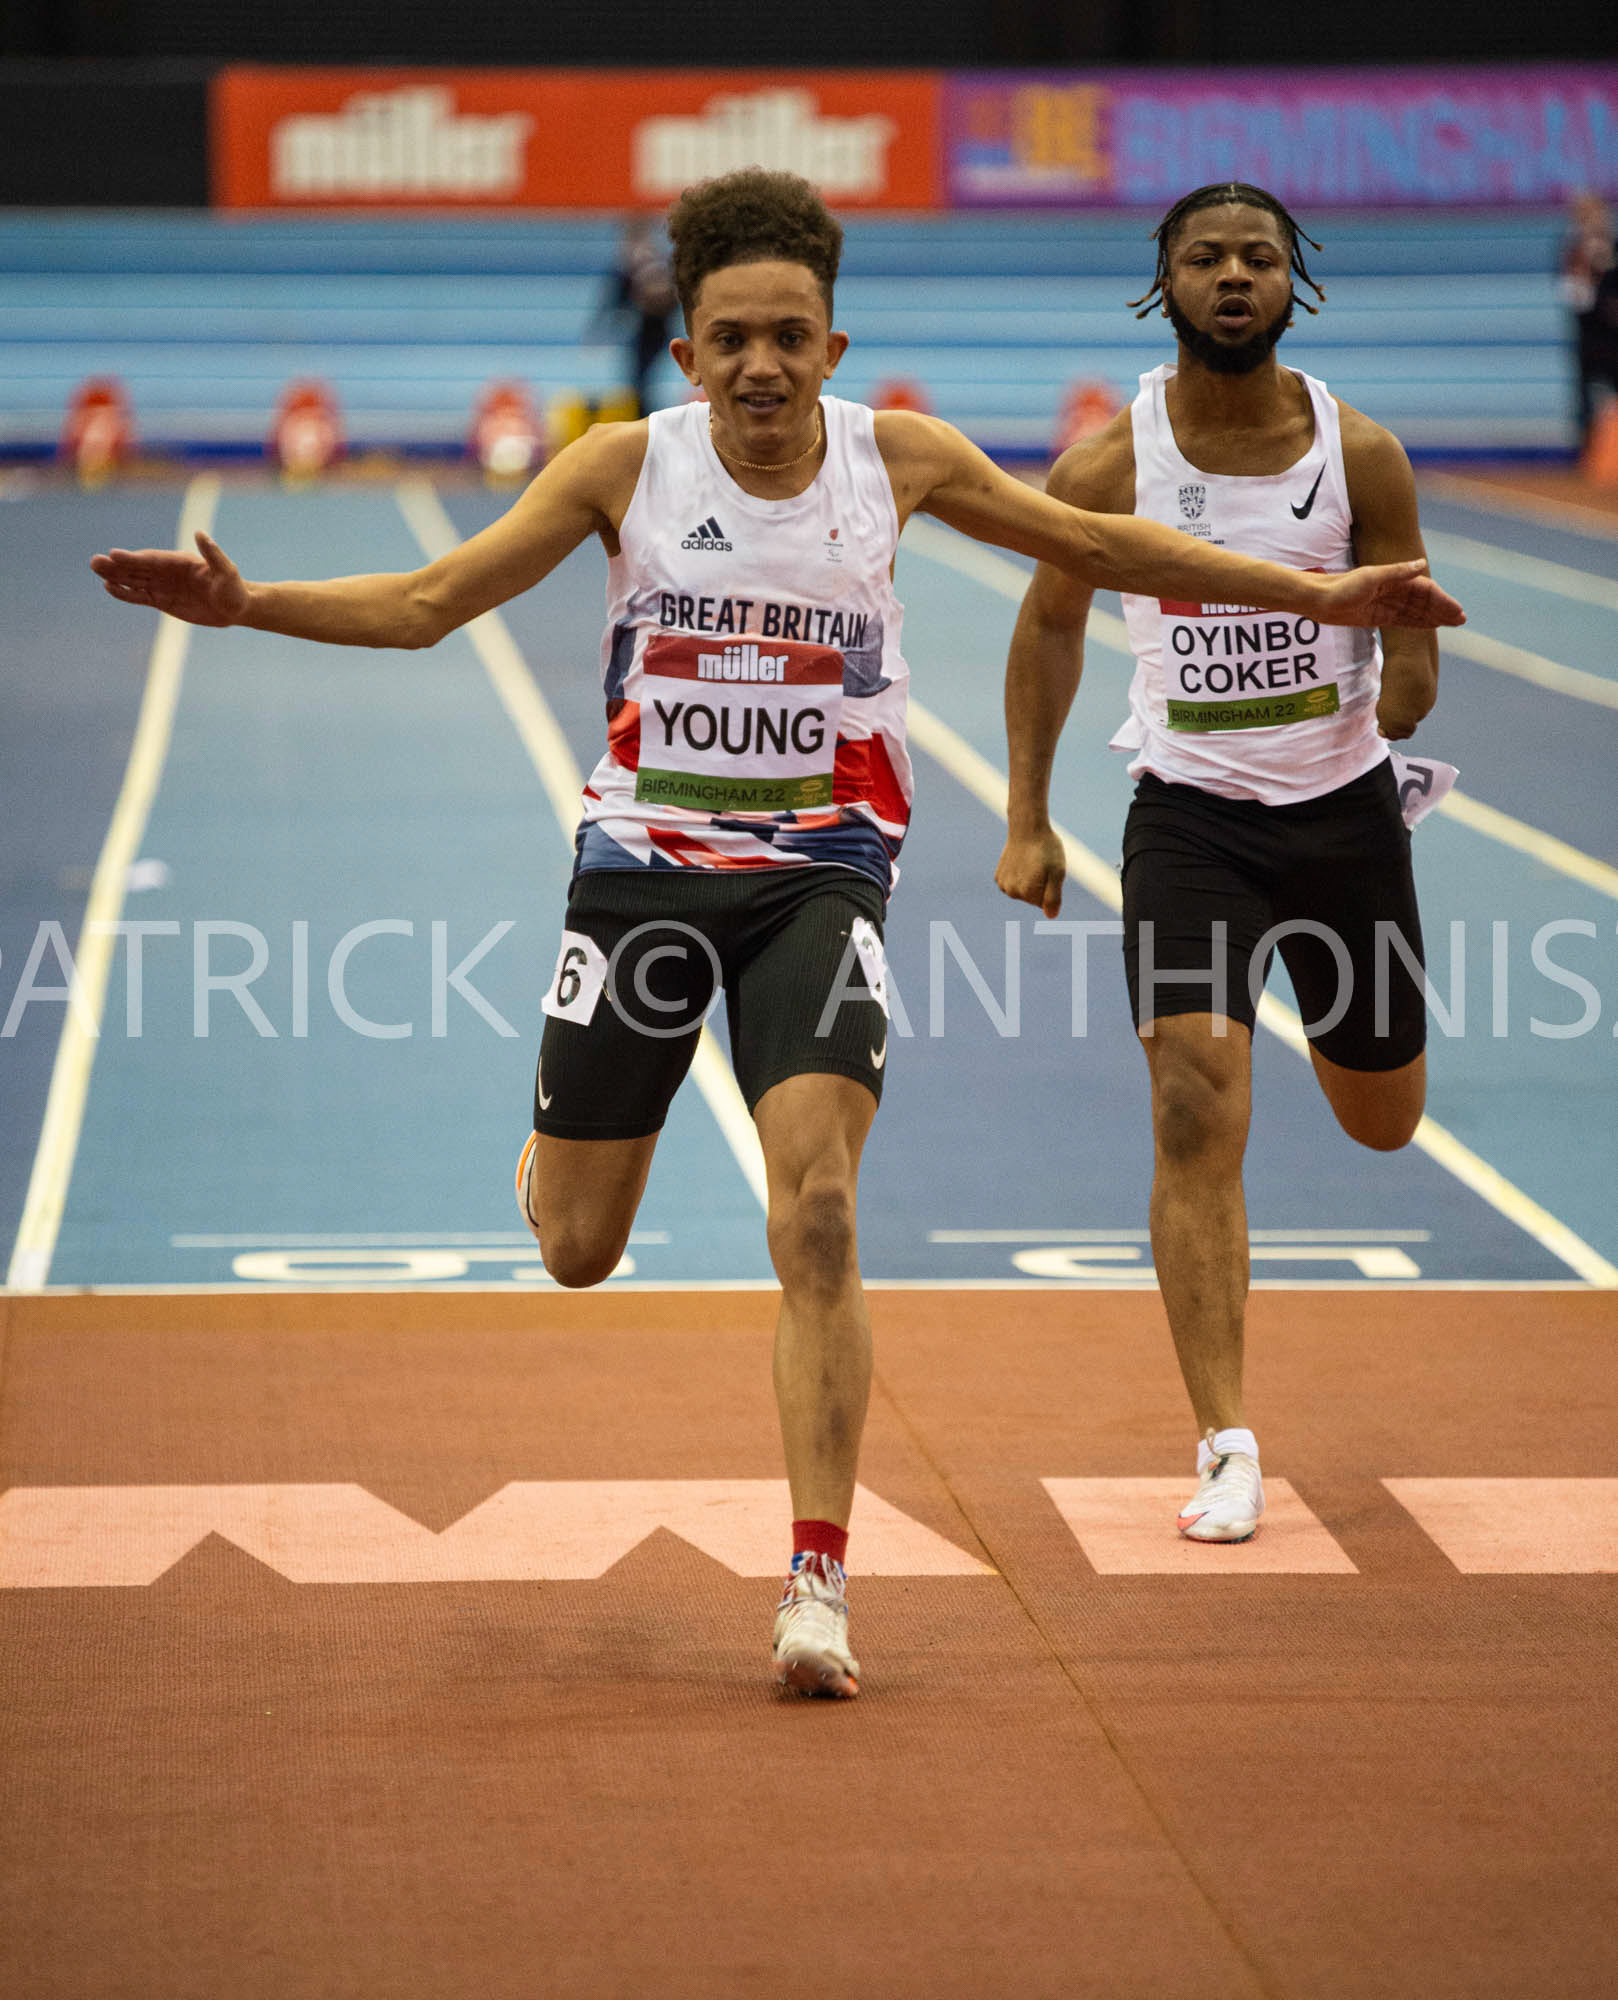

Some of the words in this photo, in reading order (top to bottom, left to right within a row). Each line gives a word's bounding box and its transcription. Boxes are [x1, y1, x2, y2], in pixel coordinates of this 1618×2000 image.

[681, 537, 733, 552] adidas
[660, 592, 754, 634] GREAT
[762, 602, 868, 648] BRITAIN
[1171, 616, 1321, 656] OYINBO
[697, 644, 790, 682] müller
[1179, 653, 1320, 694] COKER
[653, 699, 825, 754] YOUNG
[1172, 706, 1271, 725] BIRMINGHAM
[1274, 703, 1297, 717] 22
[642, 778, 758, 803] BIRMINGHAM
[761, 787, 785, 803] 22
[557, 947, 587, 1008] 6
